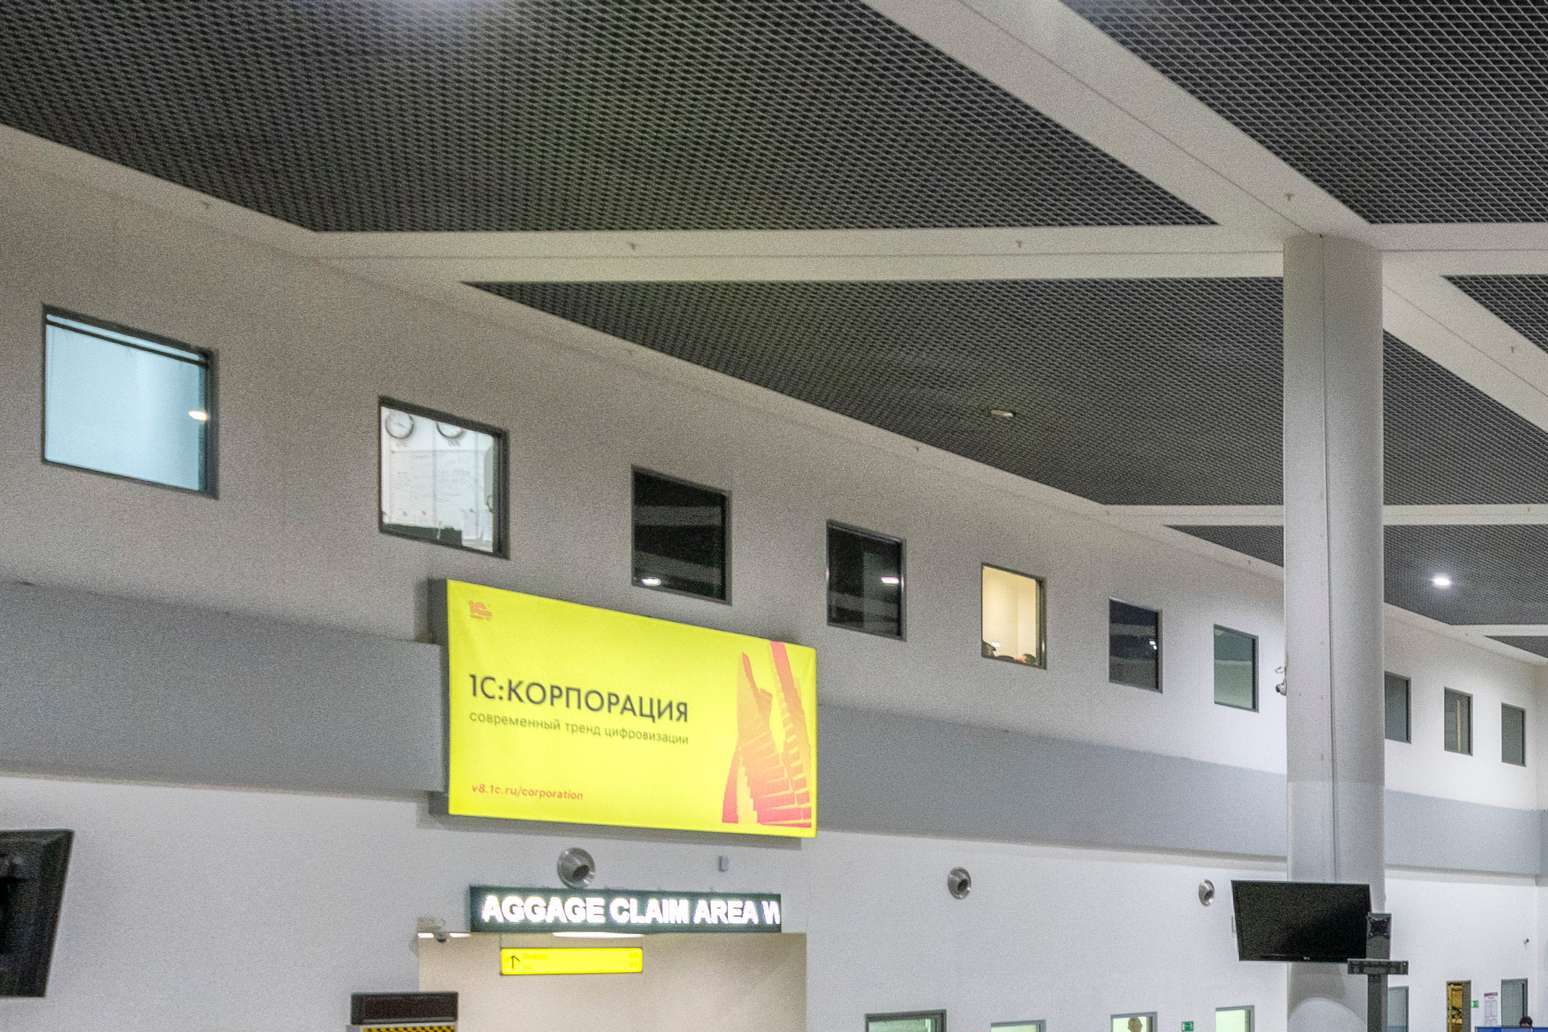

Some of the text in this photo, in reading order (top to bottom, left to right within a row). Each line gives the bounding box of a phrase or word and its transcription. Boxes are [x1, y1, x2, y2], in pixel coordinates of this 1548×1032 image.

[469, 674, 688, 723] 1С:КОРПОРАЦИЯ
[469, 711, 689, 745] современный тренд цифровизации
[609, 897, 689, 925] CLAIM
[691, 900, 758, 924] AREA
